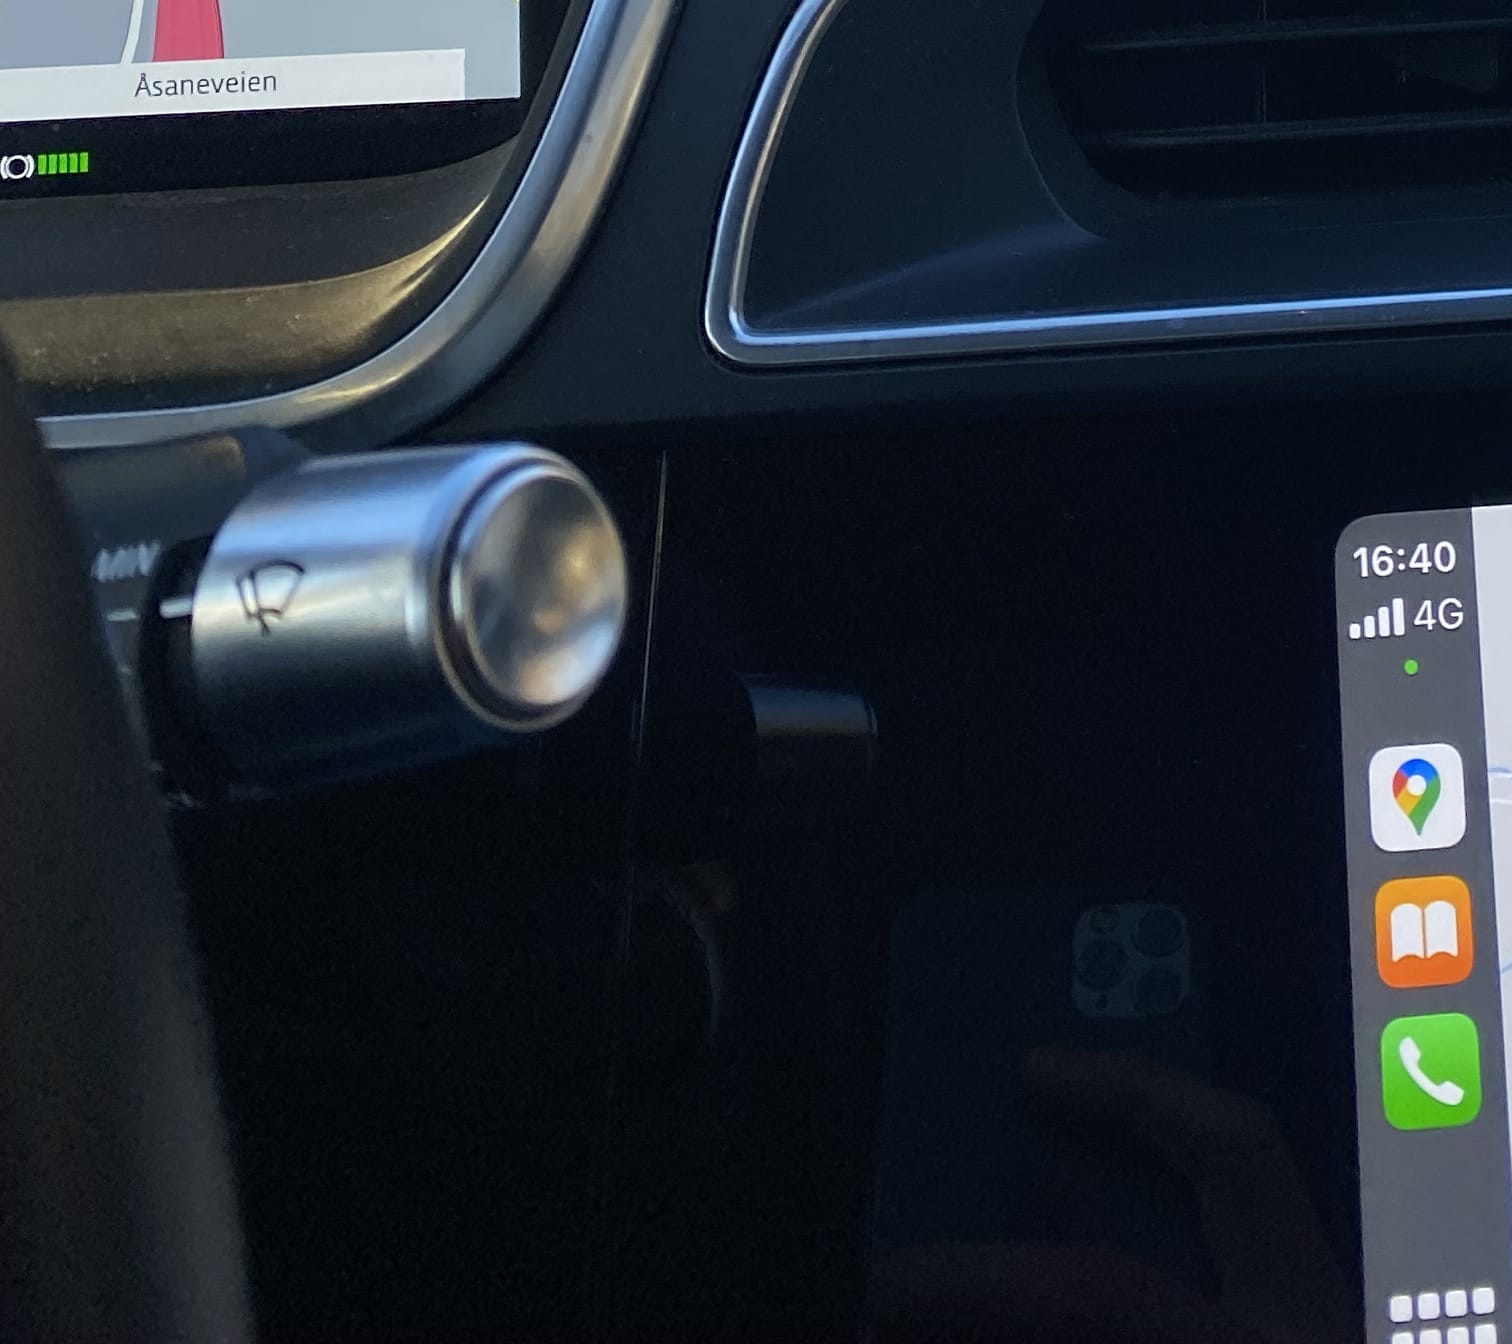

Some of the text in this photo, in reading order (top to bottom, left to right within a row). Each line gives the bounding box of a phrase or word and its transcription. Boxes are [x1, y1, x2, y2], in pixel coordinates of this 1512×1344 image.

[134, 71, 277, 97] Åsaneveien
[1352, 540, 1456, 578] 16:40
[1413, 597, 1464, 630] 4G
